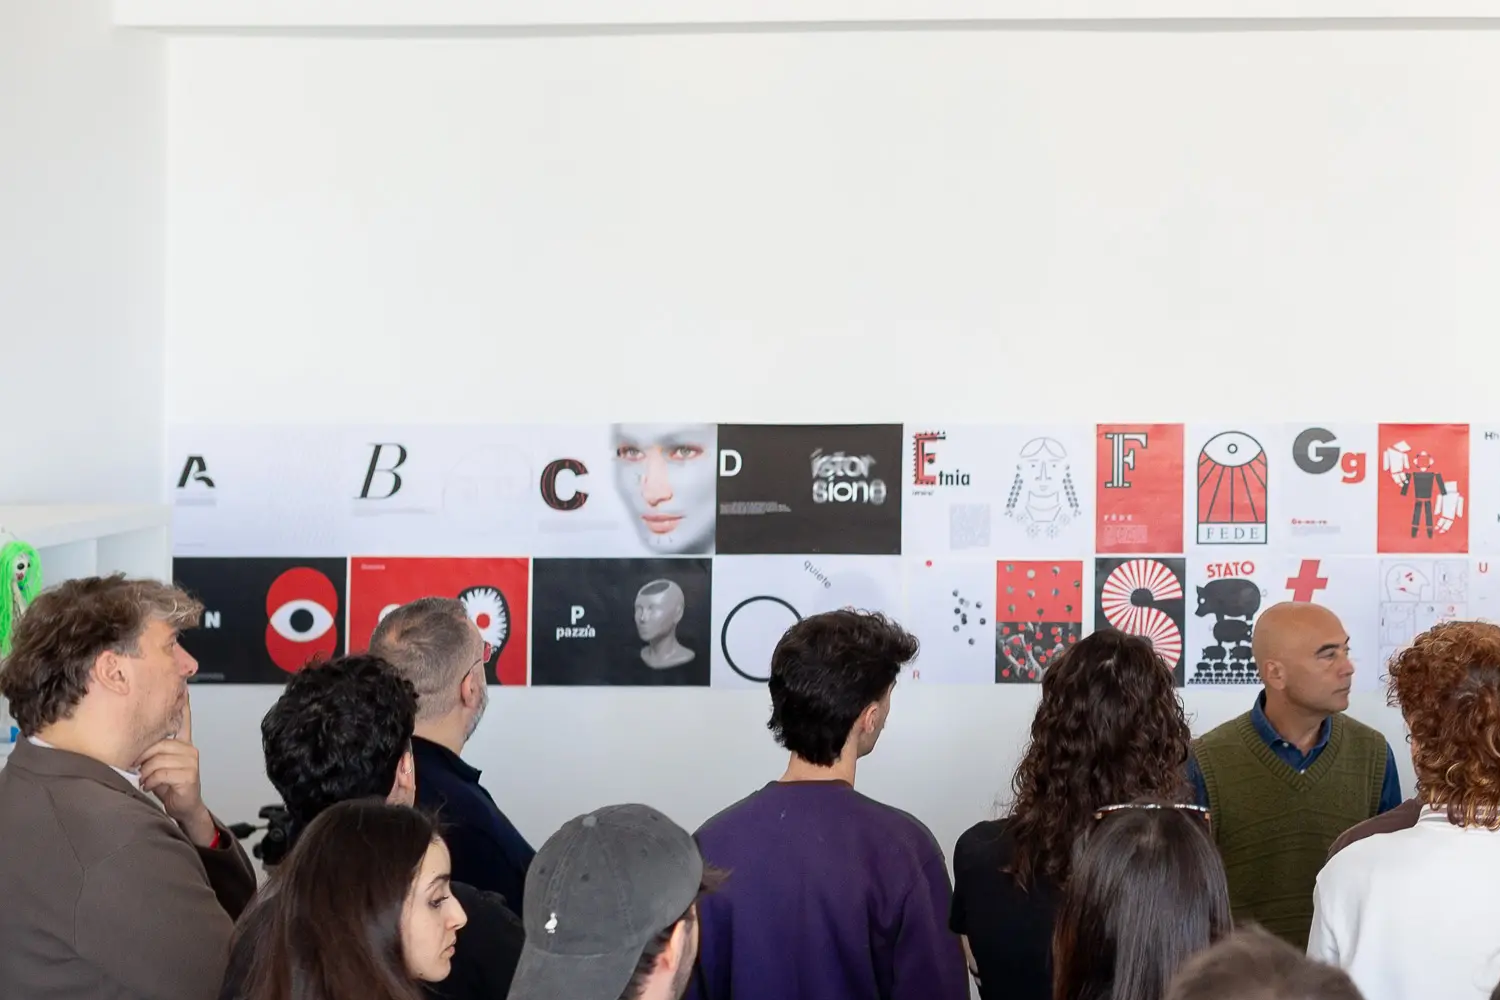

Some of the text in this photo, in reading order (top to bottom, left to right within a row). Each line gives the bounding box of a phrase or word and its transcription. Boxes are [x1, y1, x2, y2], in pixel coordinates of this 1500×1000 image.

[176, 456, 215, 488] A
[353, 443, 407, 499] B
[719, 449, 742, 477] D
[1104, 433, 1148, 488] F
[540, 458, 588, 511] C
[1206, 527, 1260, 540] FEDE
[1207, 561, 1256, 579] STATO
[204, 611, 221, 628] N
[571, 605, 585, 625] P
